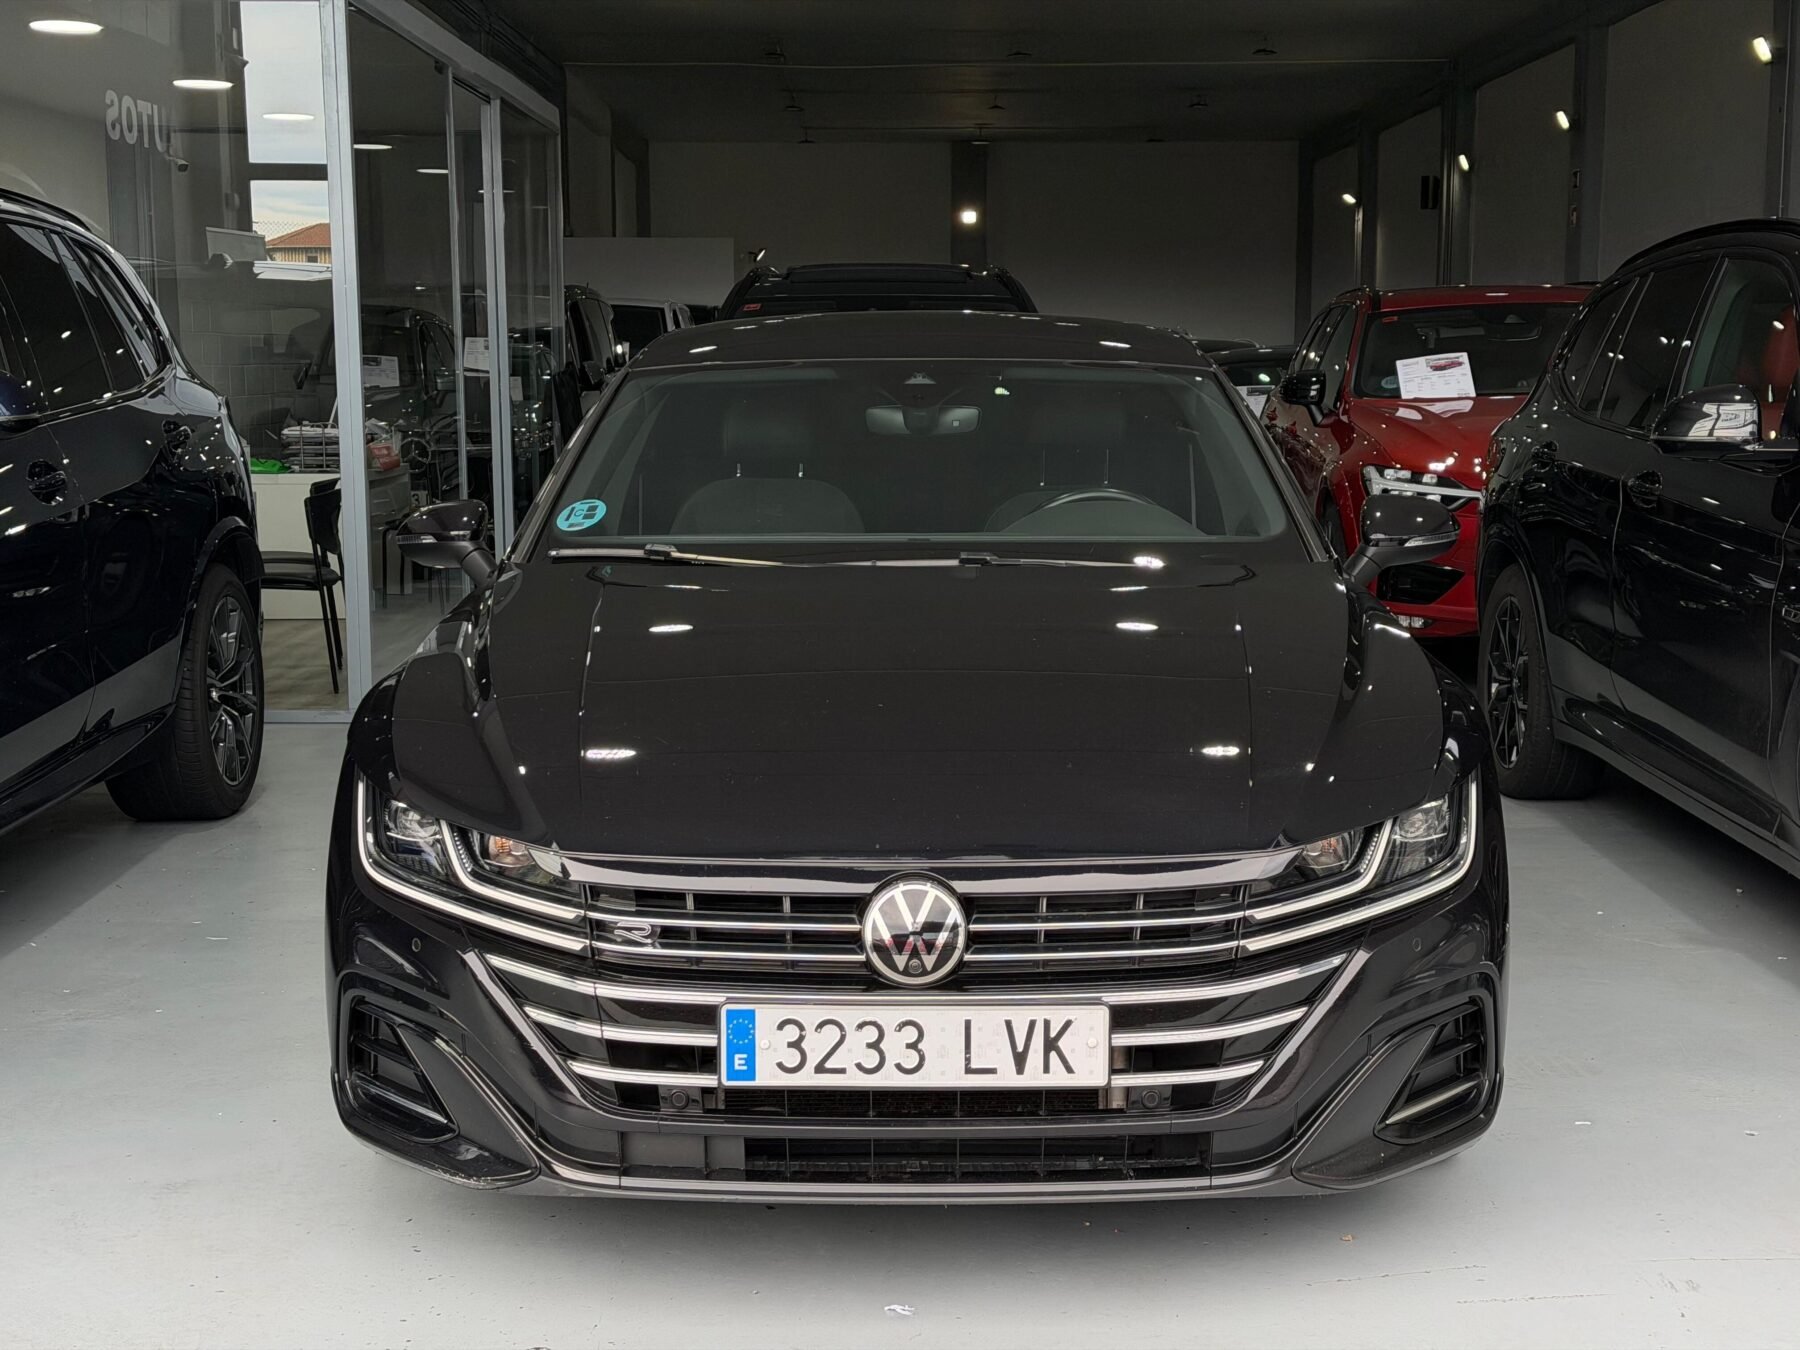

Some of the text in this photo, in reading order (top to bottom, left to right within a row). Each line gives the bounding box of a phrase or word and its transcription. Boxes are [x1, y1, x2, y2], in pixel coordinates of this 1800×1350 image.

[734, 1053, 748, 1071] E
[775, 1018, 1076, 1075] 3233 LVK
